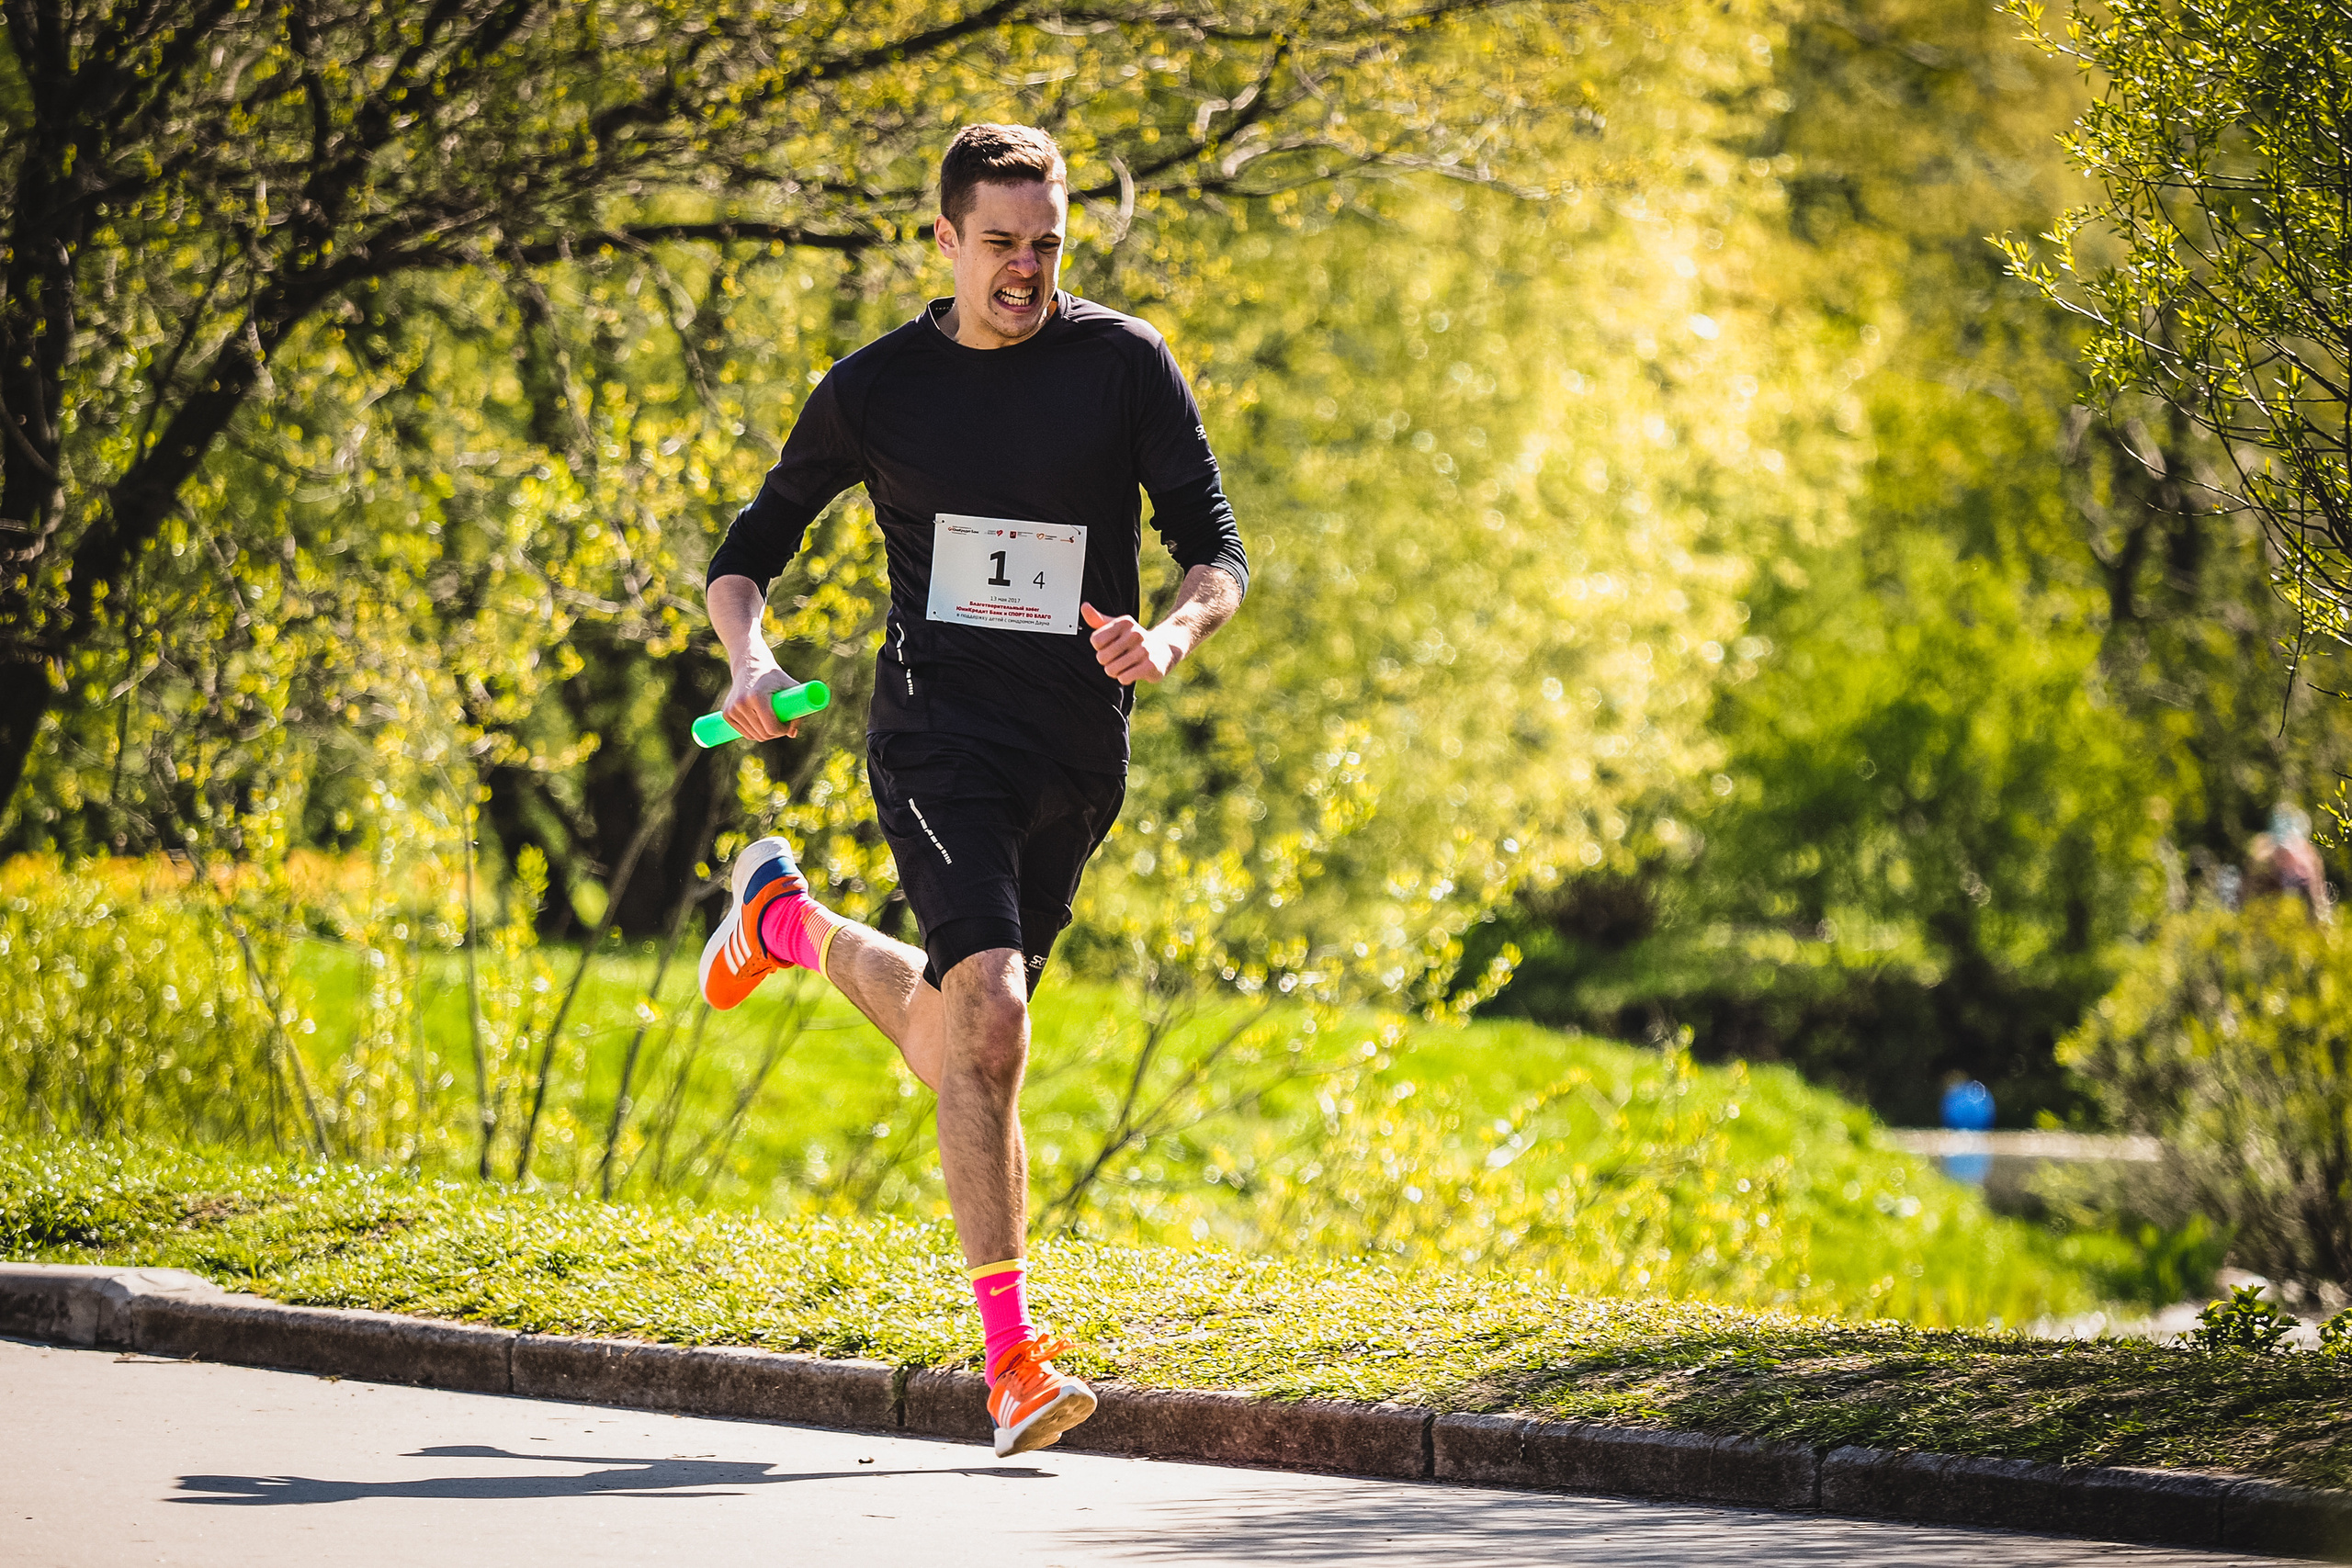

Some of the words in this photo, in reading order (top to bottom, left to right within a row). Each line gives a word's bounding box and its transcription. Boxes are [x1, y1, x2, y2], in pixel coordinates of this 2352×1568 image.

[988, 550, 1011, 586] 1
[1033, 570, 1046, 589] 4
[956, 605, 989, 615] ЮниКредит
[969, 601, 1024, 611] Благотворительный
